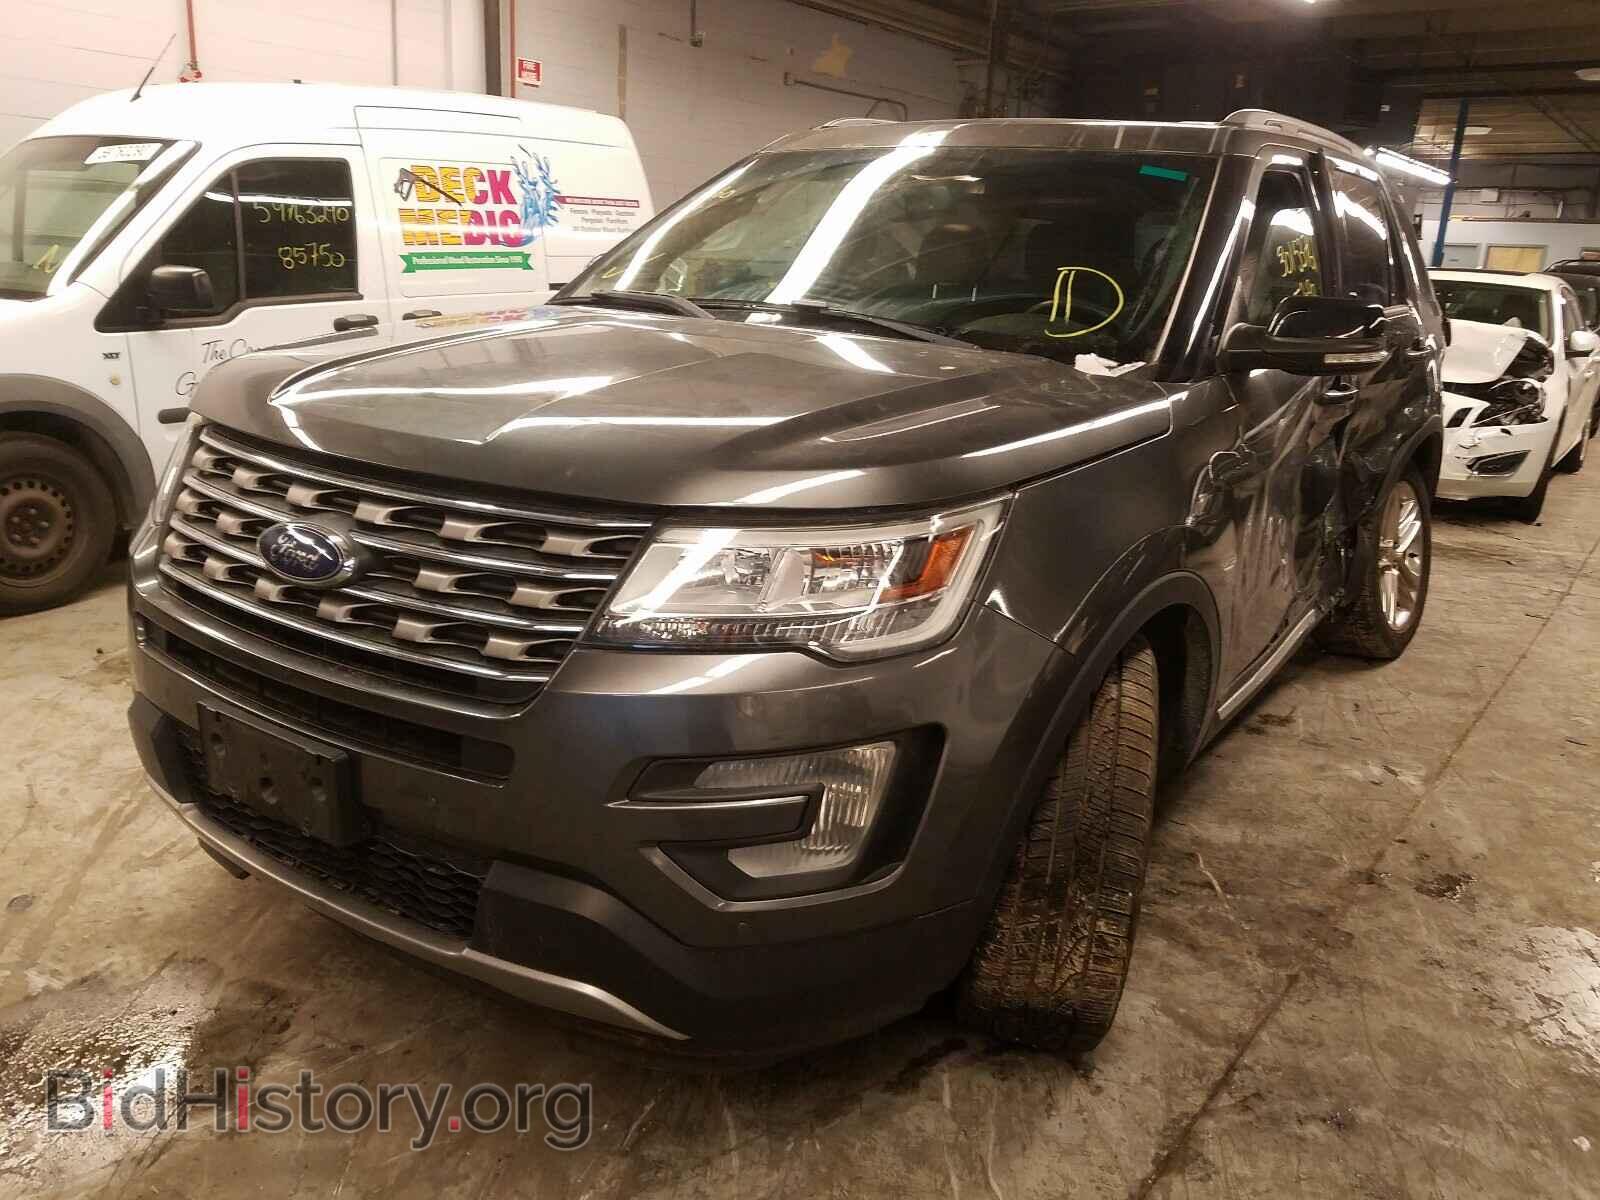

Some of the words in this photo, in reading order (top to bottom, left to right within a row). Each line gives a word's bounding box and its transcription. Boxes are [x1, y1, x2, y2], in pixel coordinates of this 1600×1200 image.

[410, 164, 518, 206] DECK
[398, 208, 524, 247] MEDIC
[201, 339, 228, 364] The
[270, 532, 321, 571] Ford
